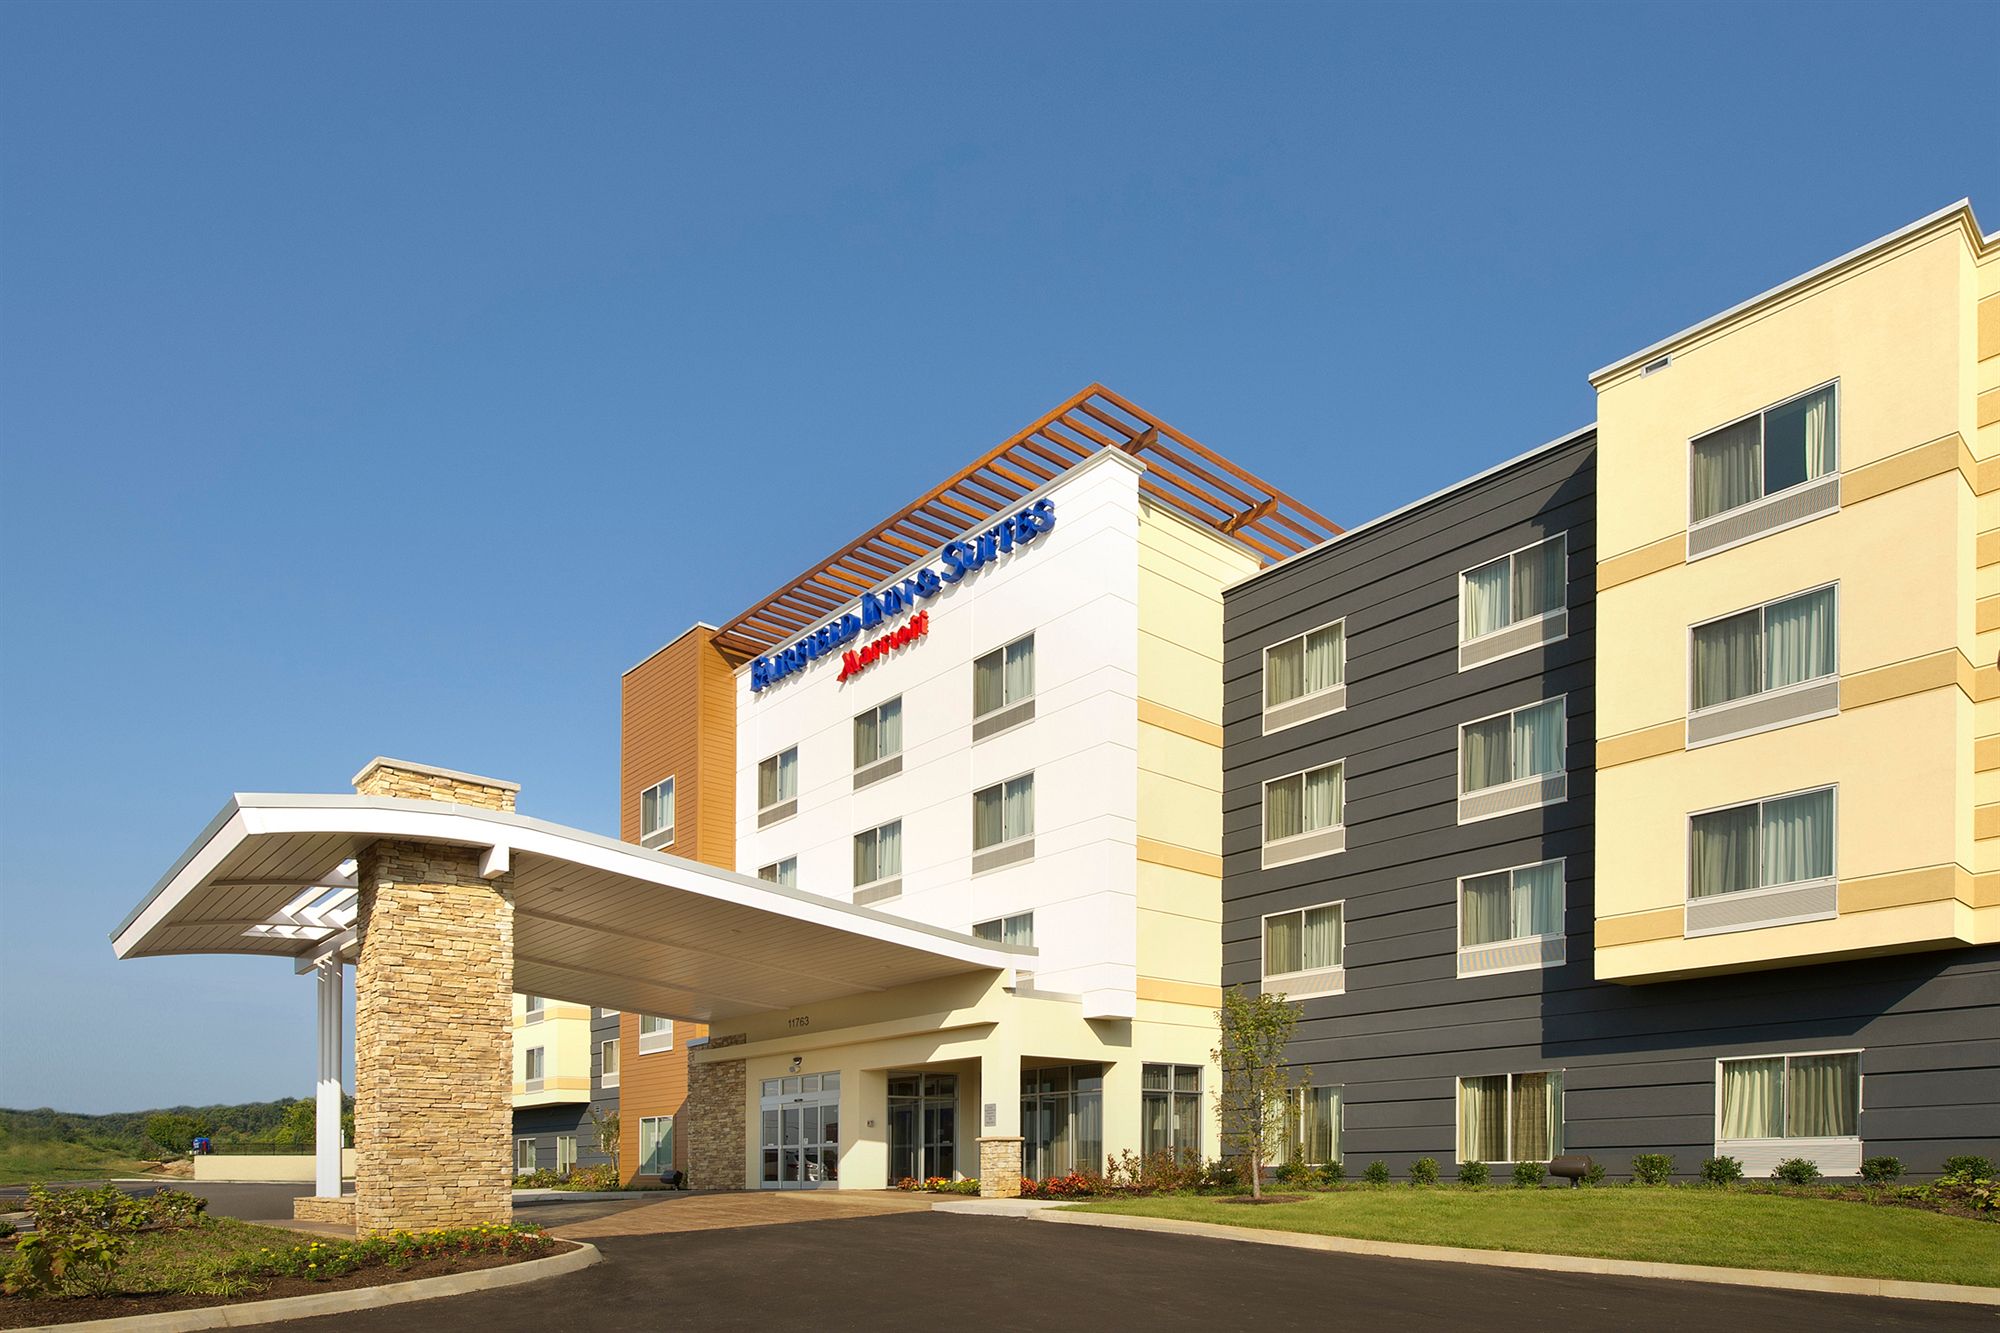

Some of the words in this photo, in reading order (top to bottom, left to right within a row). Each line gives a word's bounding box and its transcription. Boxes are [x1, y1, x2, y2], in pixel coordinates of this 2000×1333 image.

[750, 613, 862, 693] FAIRFIELD
[861, 578, 916, 631] INN
[914, 568, 943, 598] &
[941, 498, 1057, 584] SUITES
[836, 609, 930, 683] Marriott
[788, 1015, 809, 1028] 11763
